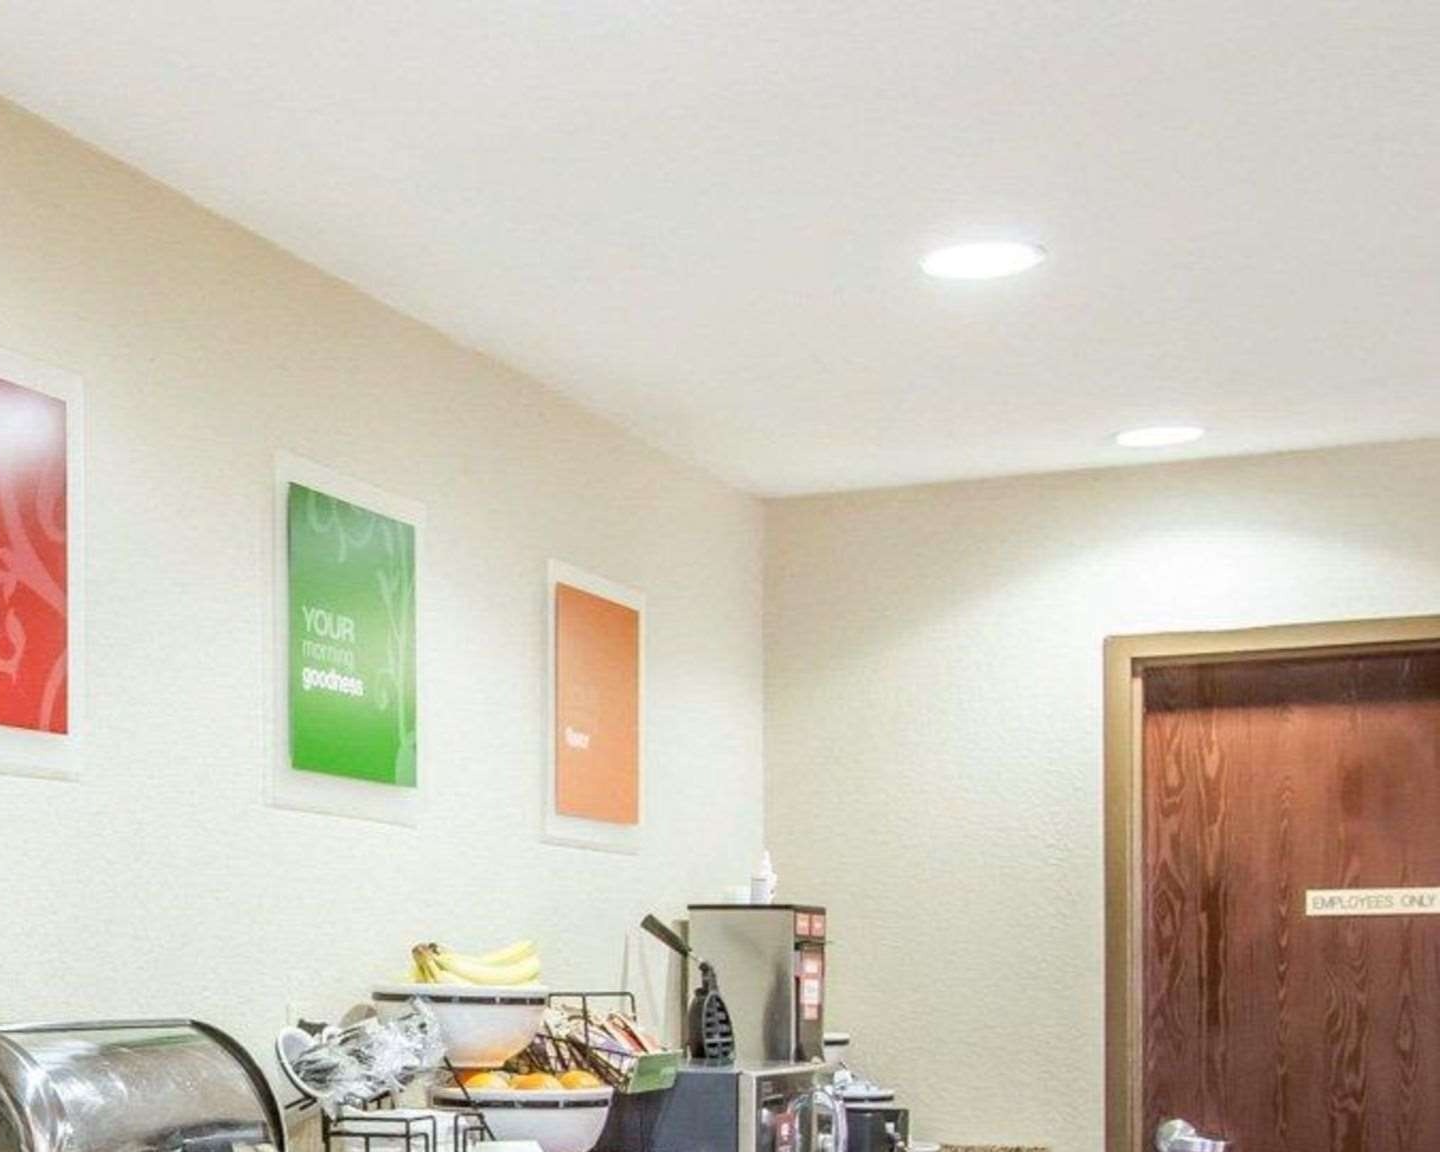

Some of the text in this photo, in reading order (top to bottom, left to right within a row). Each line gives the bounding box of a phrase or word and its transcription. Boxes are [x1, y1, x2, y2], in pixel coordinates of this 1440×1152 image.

[302, 605, 355, 644] YOUR
[302, 667, 364, 697] goodness
[1312, 892, 1438, 910] EMPLOYEES ONLY
